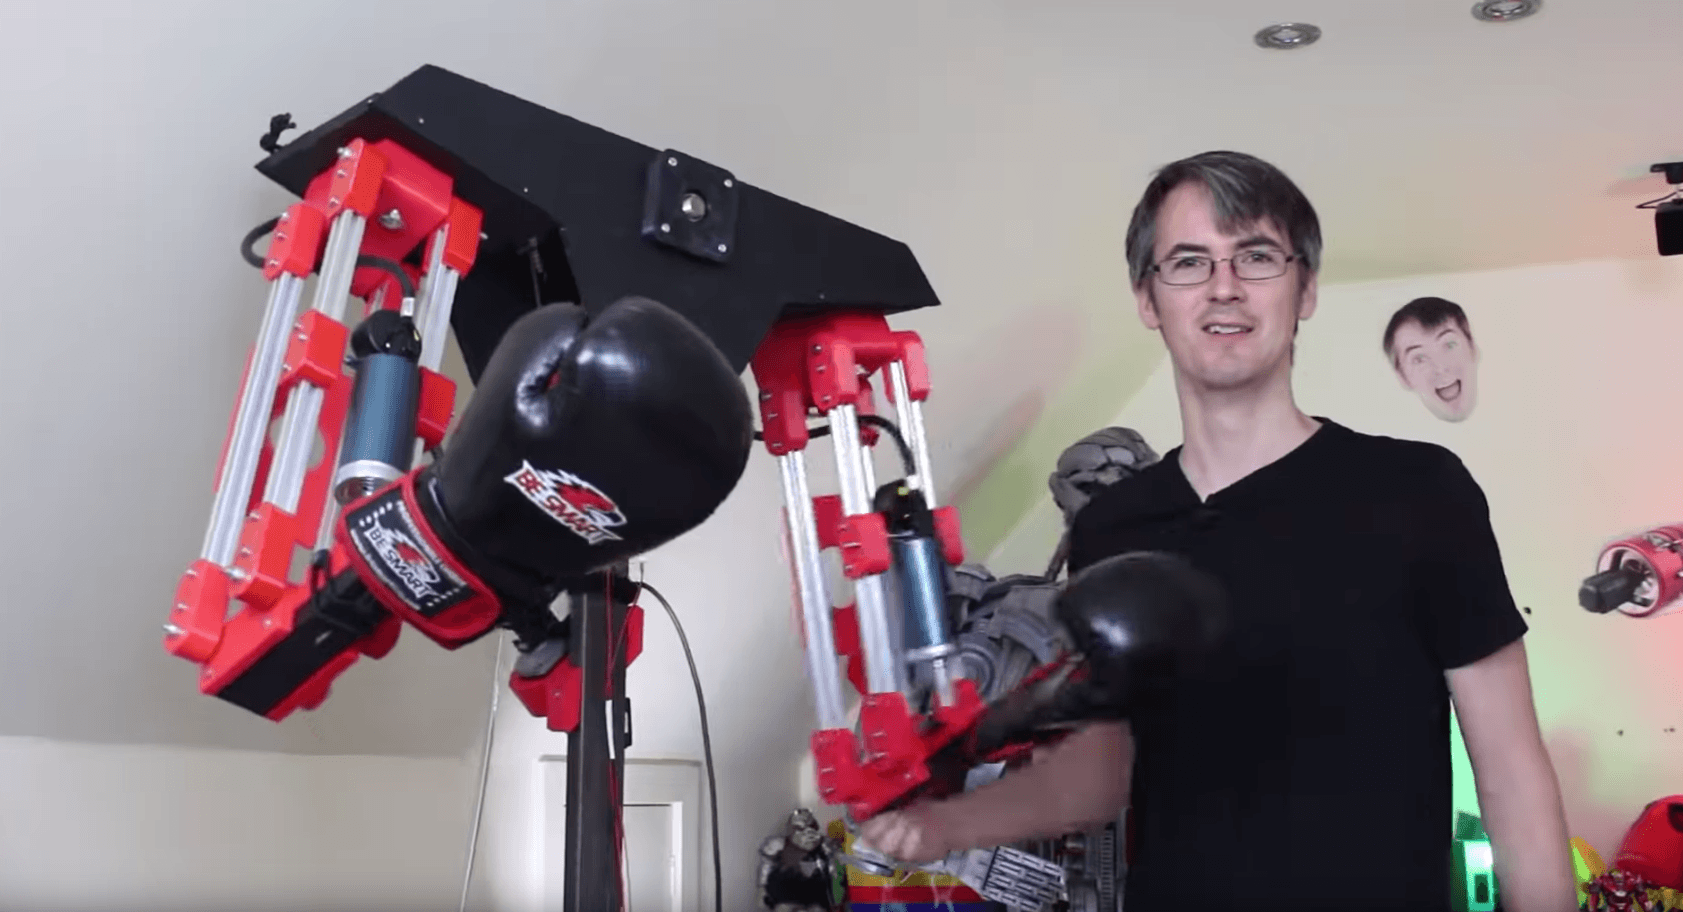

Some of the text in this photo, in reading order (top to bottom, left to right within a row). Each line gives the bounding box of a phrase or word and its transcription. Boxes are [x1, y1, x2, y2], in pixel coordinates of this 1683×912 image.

[516, 468, 606, 541] BE SMART
[369, 527, 386, 548] BE
[384, 549, 428, 595] SMART
